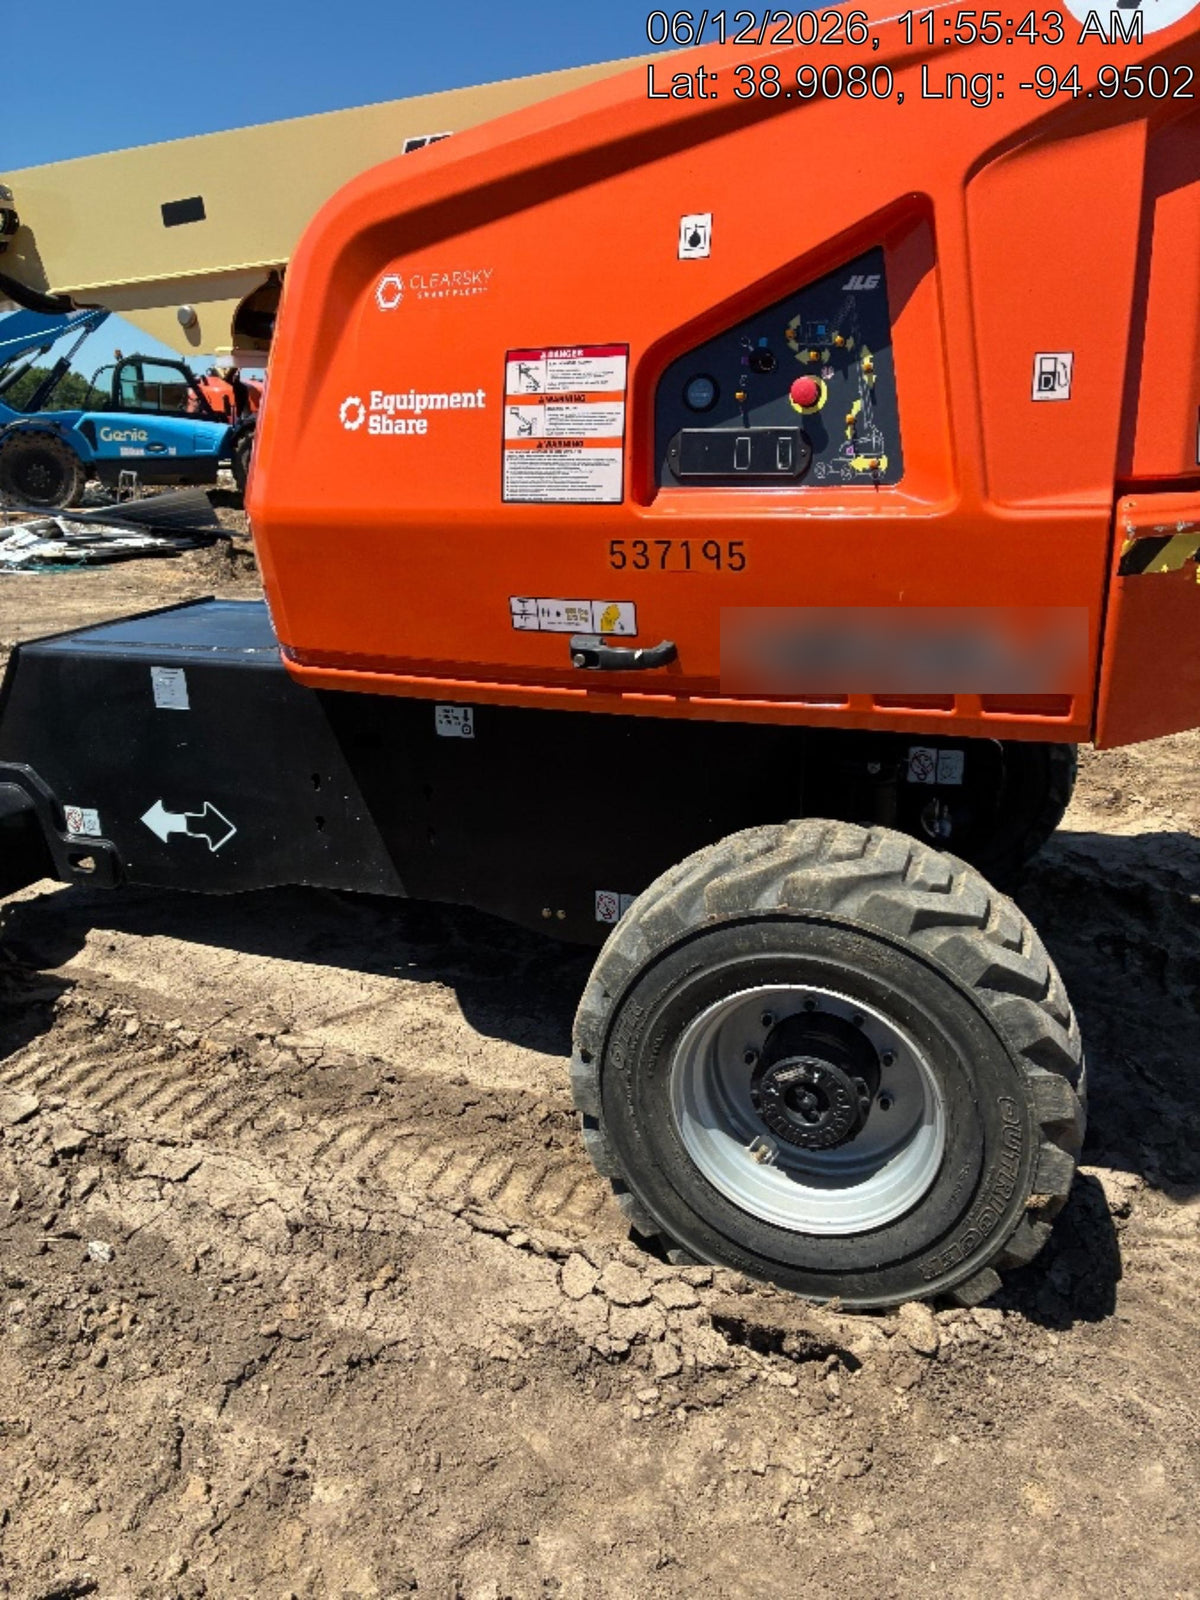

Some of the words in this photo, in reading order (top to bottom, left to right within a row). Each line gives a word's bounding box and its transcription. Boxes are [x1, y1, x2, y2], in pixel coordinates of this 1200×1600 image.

[409, 267, 493, 290] CLEARSKY
[842, 274, 881, 291] JLG
[369, 389, 486, 415] Equipment
[100, 426, 149, 442] Genie
[367, 414, 428, 435] Share
[609, 539, 747, 572] 537195
[917, 1096, 1023, 1282] OUTRIGGER
